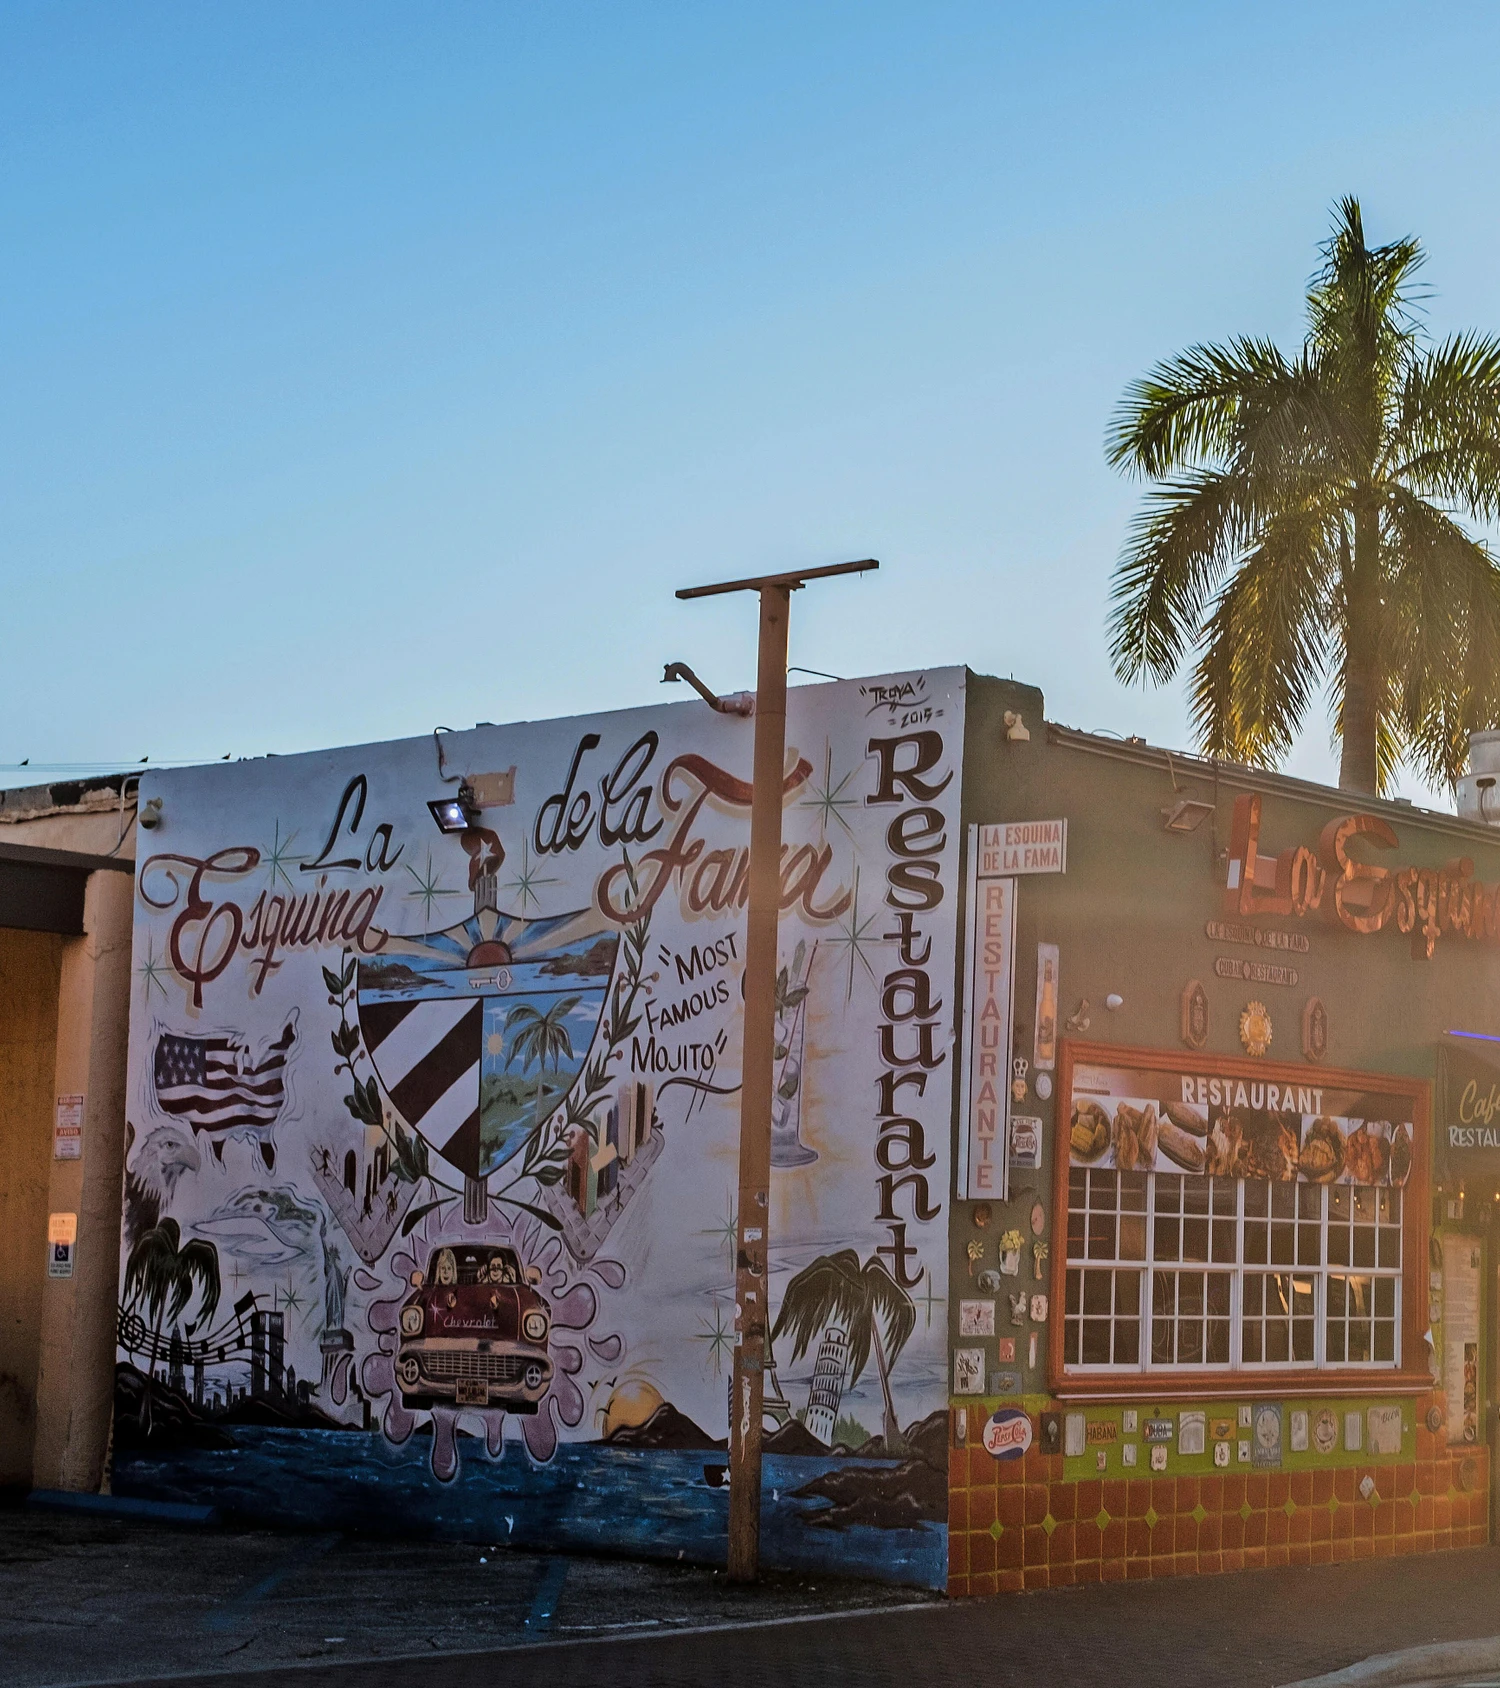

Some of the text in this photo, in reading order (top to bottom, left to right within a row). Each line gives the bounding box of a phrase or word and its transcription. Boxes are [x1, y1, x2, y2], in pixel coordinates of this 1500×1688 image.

[299, 773, 405, 873] La
[535, 729, 664, 855] de la
[983, 847, 1060, 871] DE LA FAMA
[984, 823, 1061, 847] LA ESQUINA
[1223, 793, 1328, 917] La
[139, 846, 390, 1009] Esquina
[645, 979, 730, 1034] FAMOUS
[866, 730, 954, 1289] Restaurant
[976, 885, 1004, 1190] RESTAURANTE
[1181, 1075, 1324, 1115] RESTAURANT
[444, 1314, 496, 1329] Chevrolet
[1086, 1423, 1118, 1440] HABANA
